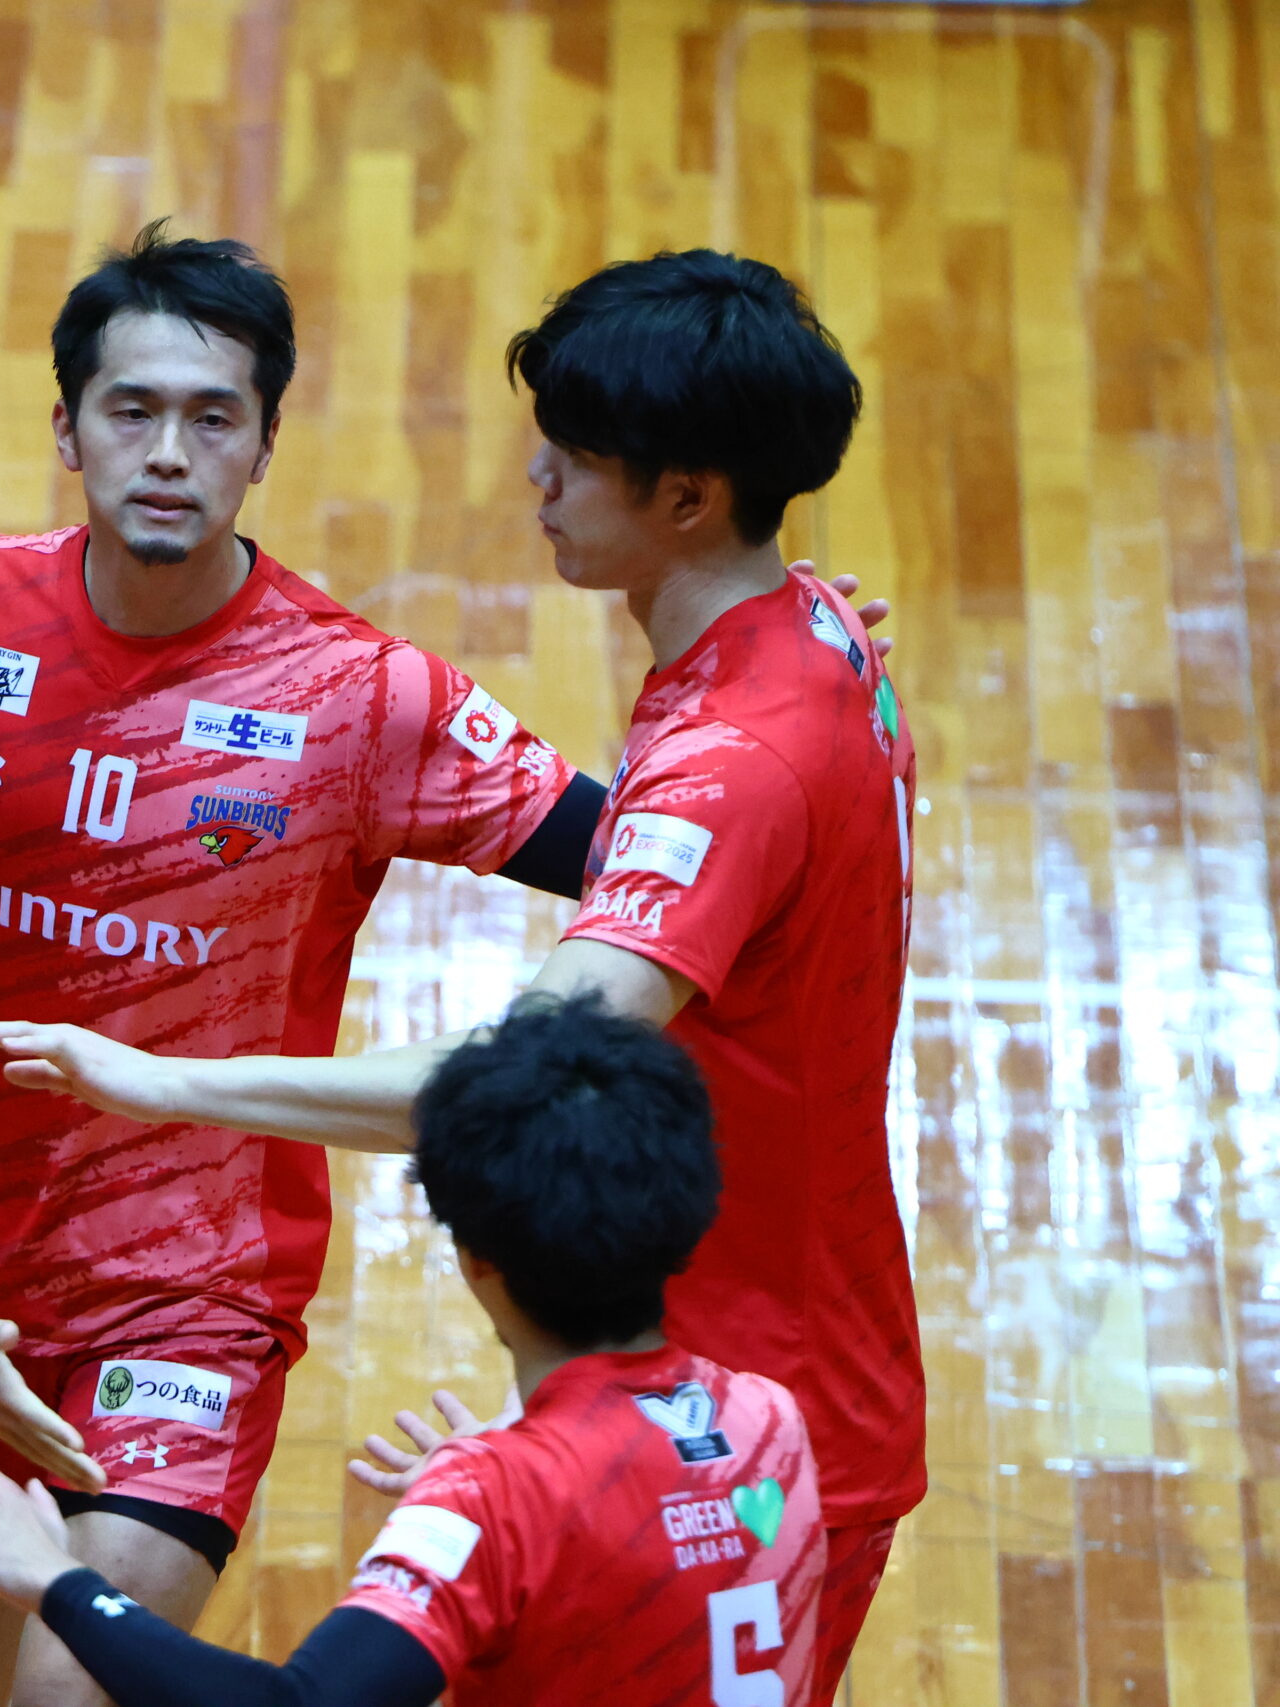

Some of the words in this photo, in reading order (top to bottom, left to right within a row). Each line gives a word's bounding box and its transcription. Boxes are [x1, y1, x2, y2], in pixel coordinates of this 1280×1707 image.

[7, 652, 22, 661] GIN
[61, 748, 138, 842] 10
[215, 784, 276, 800] SUNTORY
[185, 795, 292, 841] SUNBIRDS
[136, 1381, 223, 1412] つの食品
[661, 1497, 737, 1542] GREEN
